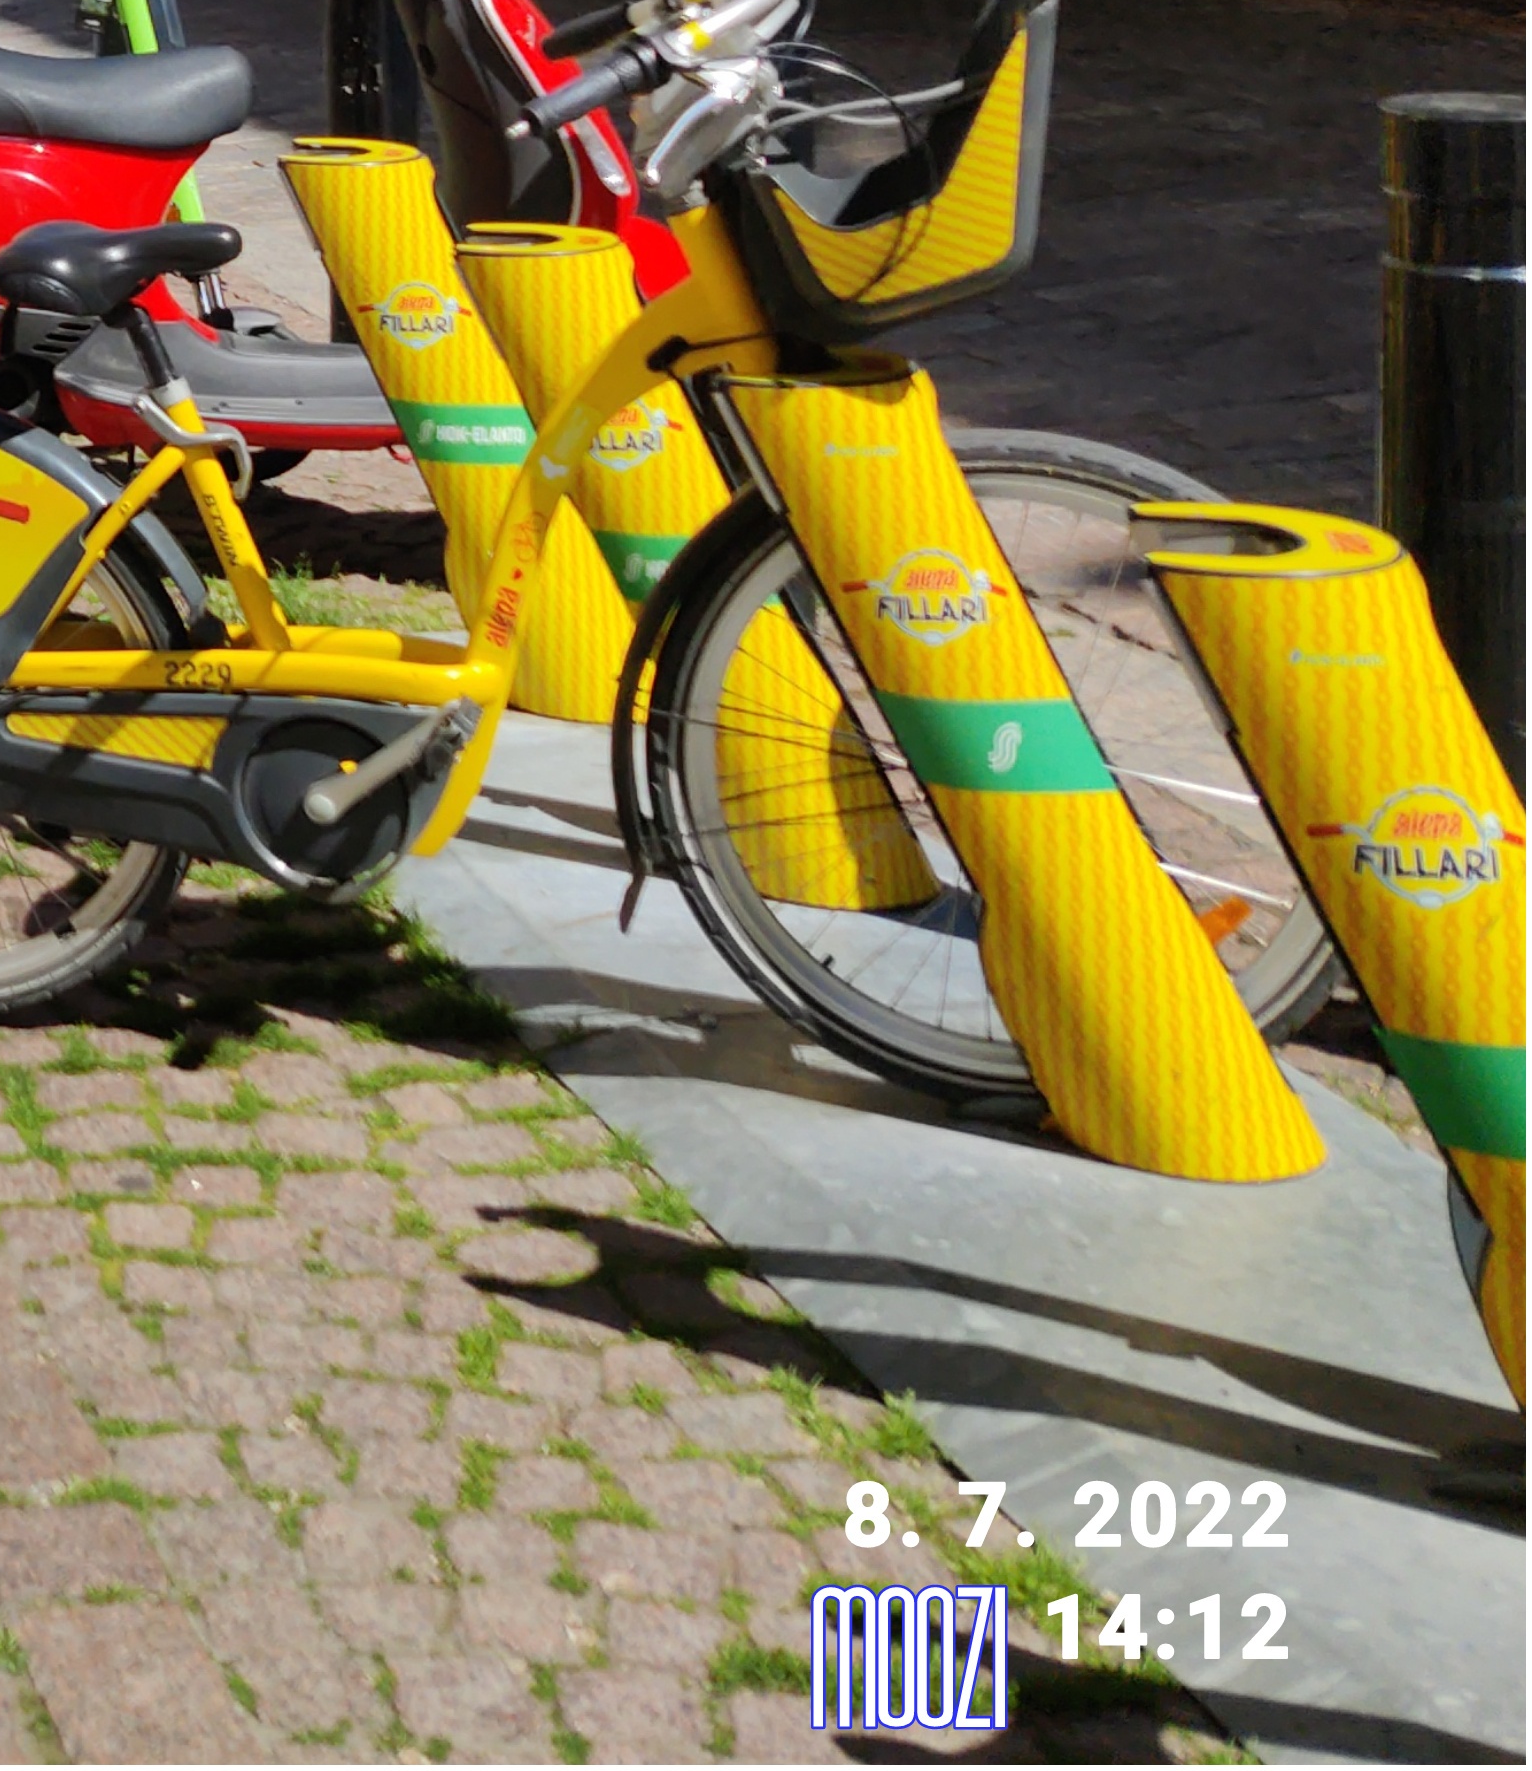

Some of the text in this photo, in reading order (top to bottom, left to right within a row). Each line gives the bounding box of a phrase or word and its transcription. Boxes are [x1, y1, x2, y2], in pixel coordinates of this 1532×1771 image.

[378, 314, 454, 333] FILLARI
[876, 595, 987, 623] FILLARI
[163, 660, 232, 691] 2229
[1352, 844, 1500, 881] FILLARI
